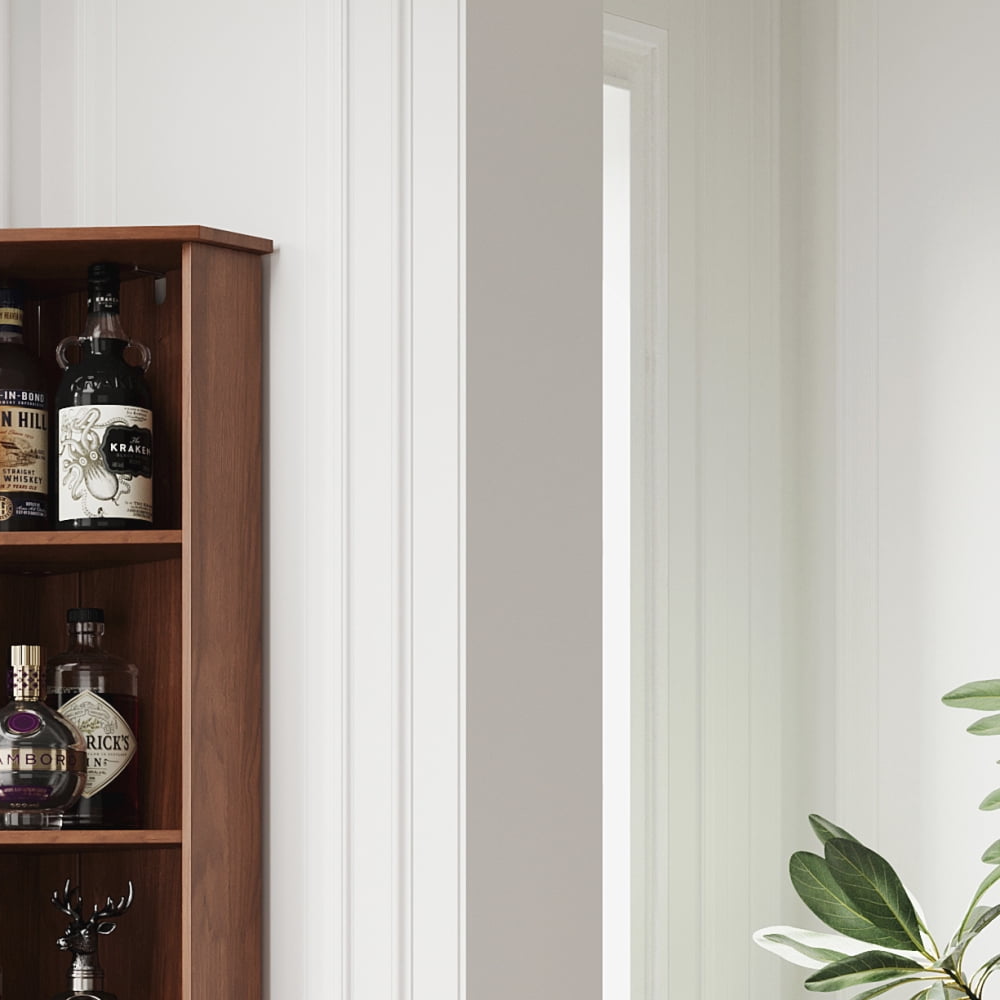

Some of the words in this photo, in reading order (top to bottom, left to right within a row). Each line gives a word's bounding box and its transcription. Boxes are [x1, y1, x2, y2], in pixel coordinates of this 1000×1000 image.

[18, 412, 48, 430] HILL
[110, 442, 151, 456] KRAKEN
[4, 475, 42, 484] WHISKEY
